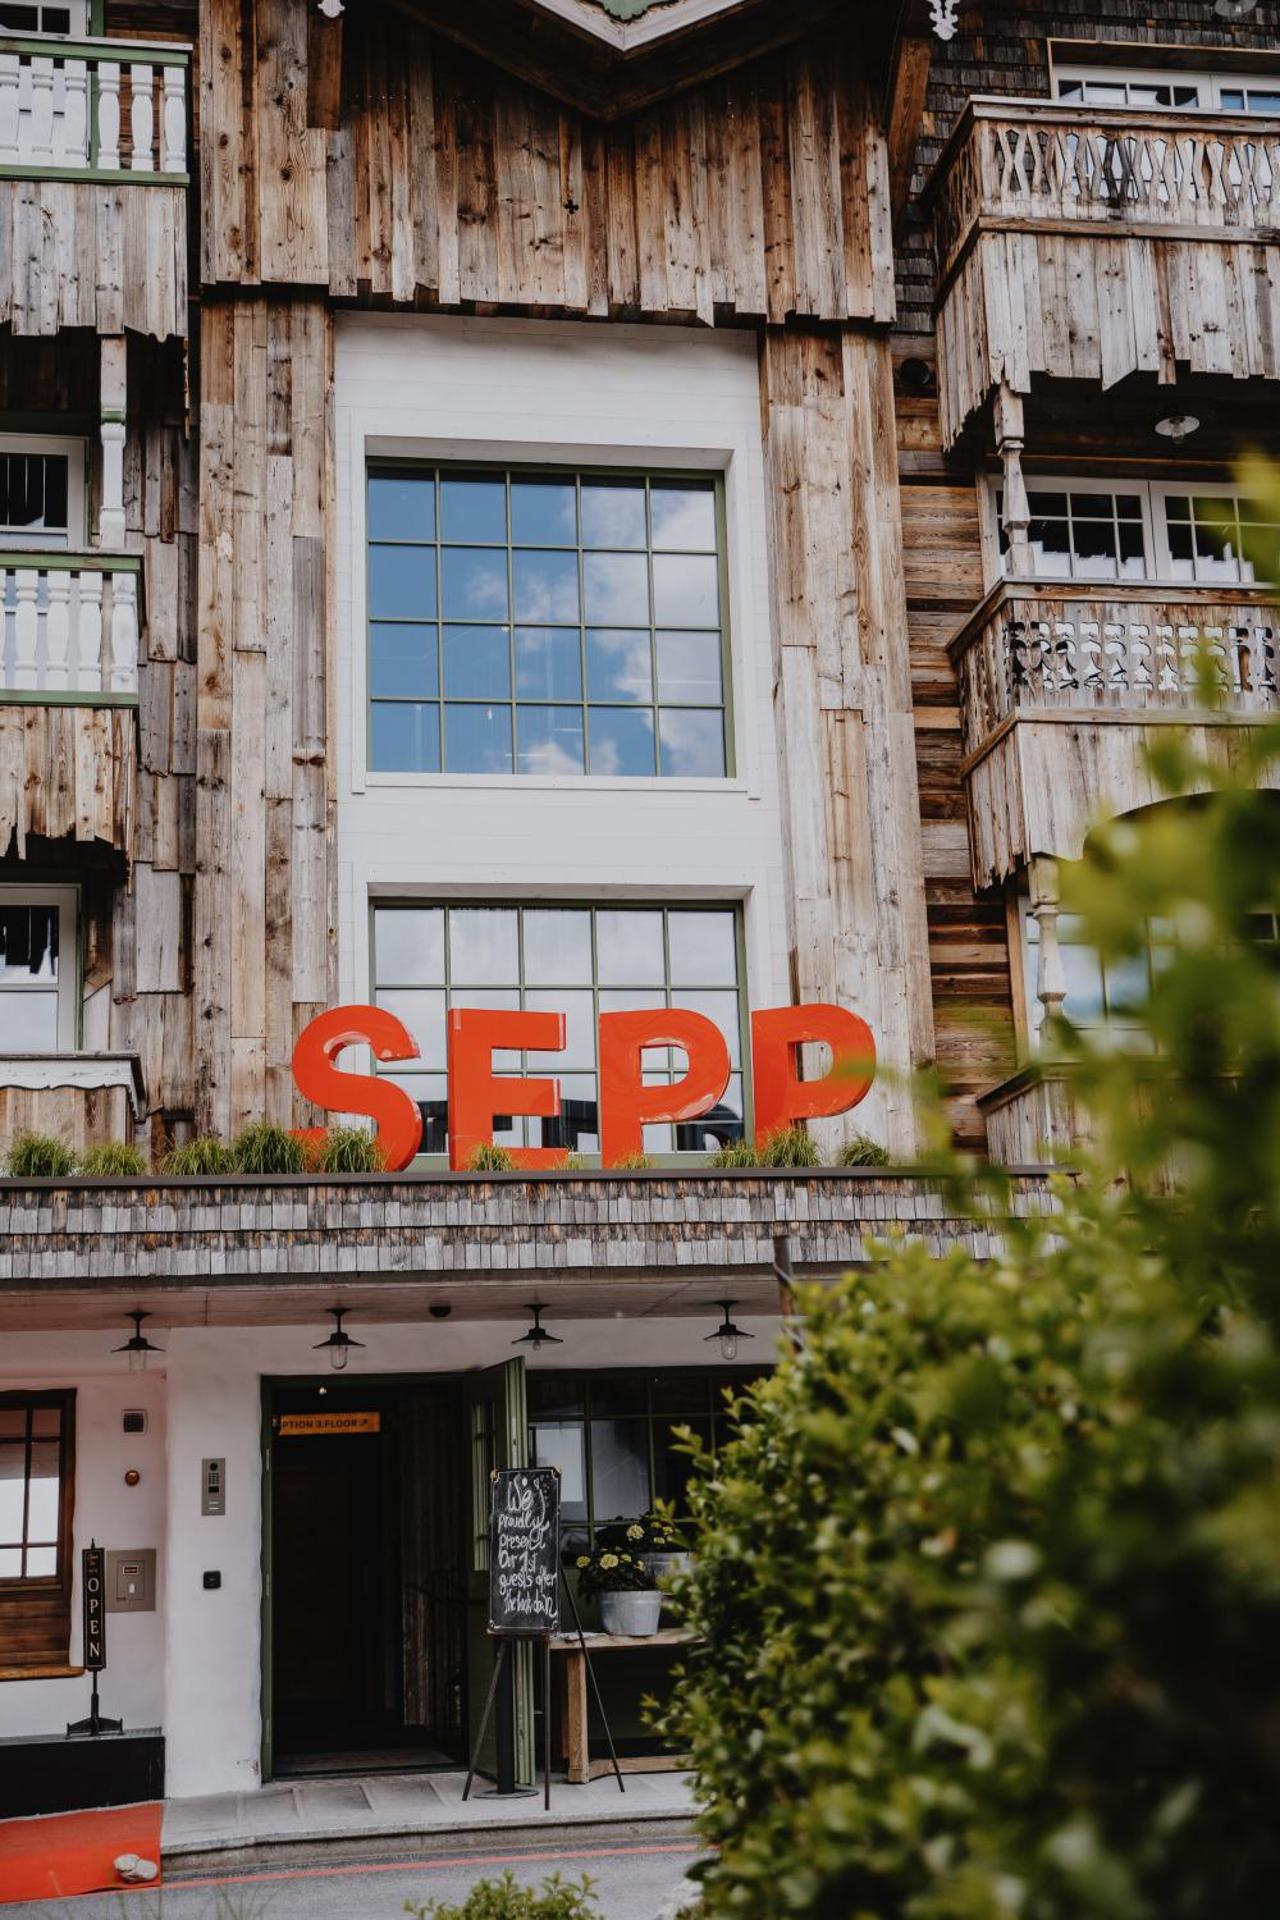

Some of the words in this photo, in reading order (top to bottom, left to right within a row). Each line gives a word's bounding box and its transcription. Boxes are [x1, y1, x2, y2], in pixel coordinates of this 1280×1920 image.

[289, 1003, 875, 1172] SEPP
[508, 1473, 534, 1513] We
[498, 1508, 549, 1533] proudly
[498, 1532, 546, 1552] present
[499, 1570, 533, 1595] guests
[87, 1577, 100, 1657] OPEN
